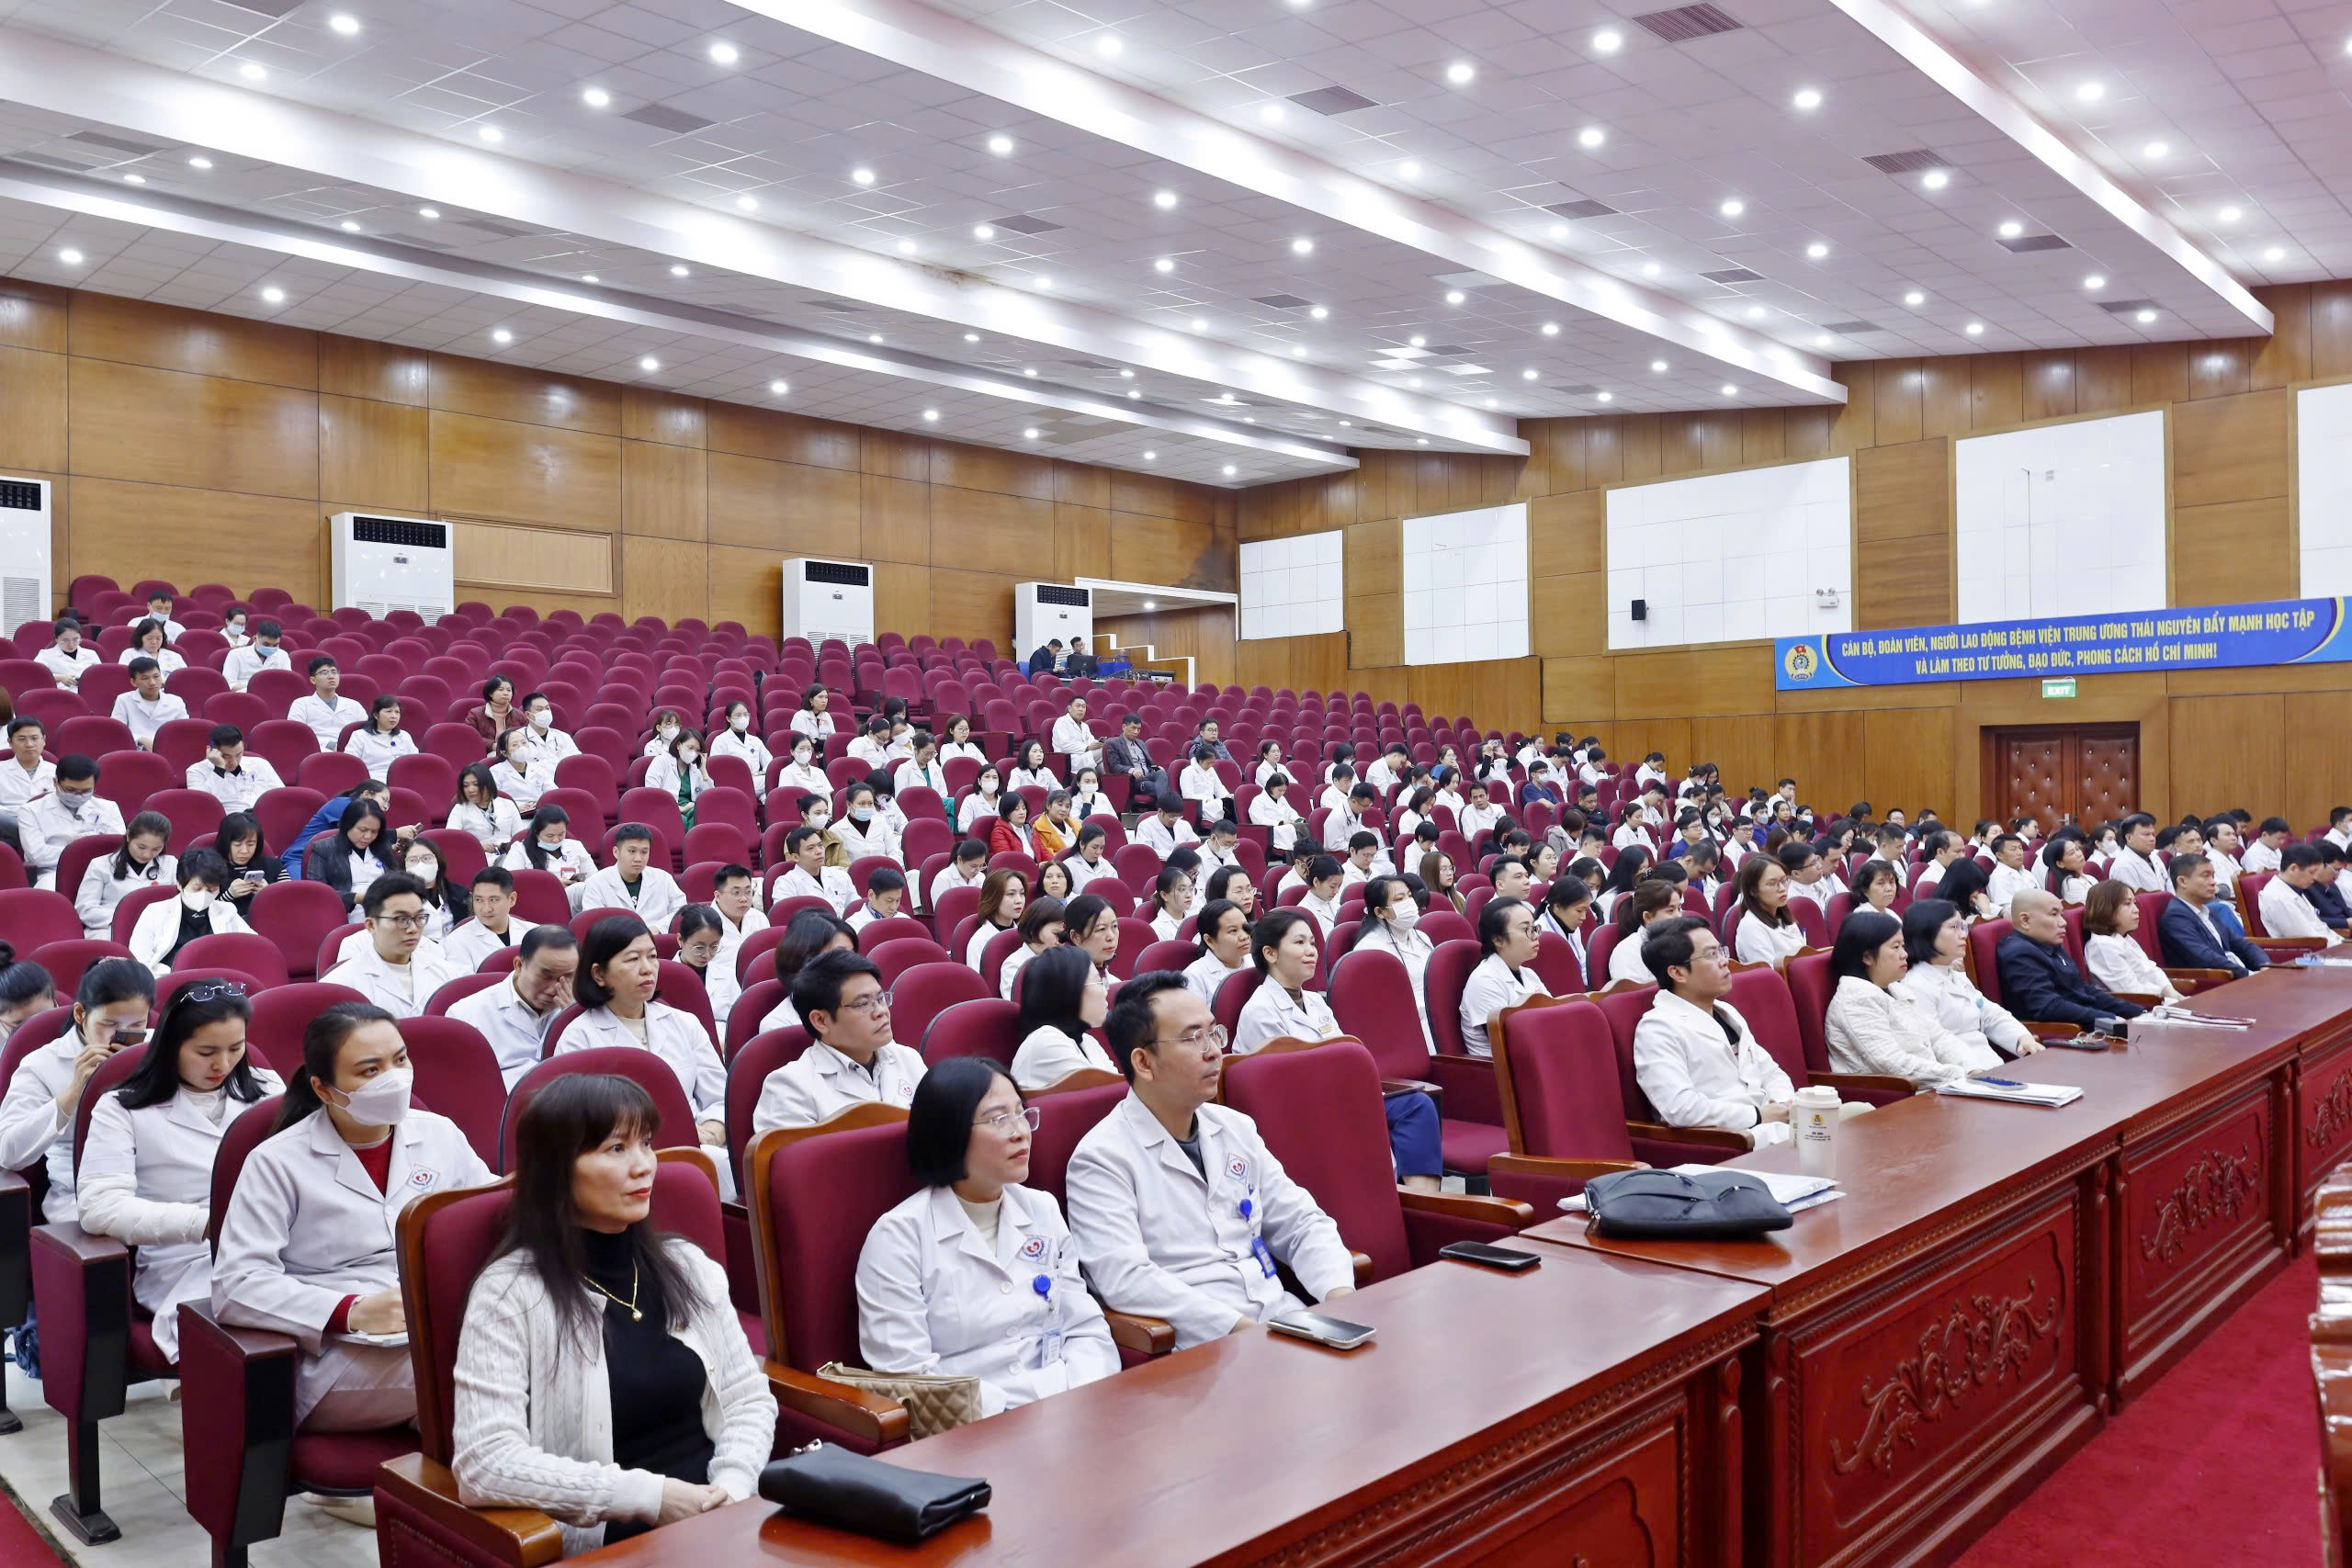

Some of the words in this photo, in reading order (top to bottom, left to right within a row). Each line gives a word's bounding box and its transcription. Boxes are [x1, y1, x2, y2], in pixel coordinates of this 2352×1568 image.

[1842, 640, 1860, 657] CÁN
[1862, 638, 1876, 658] BỘ,
[1879, 637, 1903, 655] ĐOÀN
[1905, 635, 1928, 653] VIÊN,
[1930, 632, 1959, 651] NGƯỜI
[1961, 633, 1978, 649] LAO
[1981, 629, 2007, 650] ĐỘNG
[2009, 627, 2035, 649] BỆNH
[2038, 626, 2061, 647] VIỆN
[2064, 626, 2097, 642] TRUNG
[2099, 623, 2128, 640] ƯƠNG
[2131, 618, 2154, 637] THÁI
[2157, 615, 2200, 637] NGUYÊN
[2228, 614, 2263, 635] MẠNH
[2266, 612, 2289, 633] HỌC
[2292, 608, 2315, 632] TẬP
[1916, 658, 1928, 675] VÀ
[1929, 657, 1950, 674] LÀM
[1951, 657, 1974, 672] THEO
[1977, 655, 1990, 671] TƯ
[1992, 650, 2026, 671] TƯỞNG,
[2029, 652, 2048, 671] ĐẠO
[2051, 649, 2075, 668] ĐỨC,
[2076, 649, 2112, 666] PHONG
[2114, 645, 2143, 664] CÁCH
[2163, 642, 2181, 660] CHÍ
[2184, 642, 2218, 660] MINH!
[2048, 686, 2071, 695] EXIT
